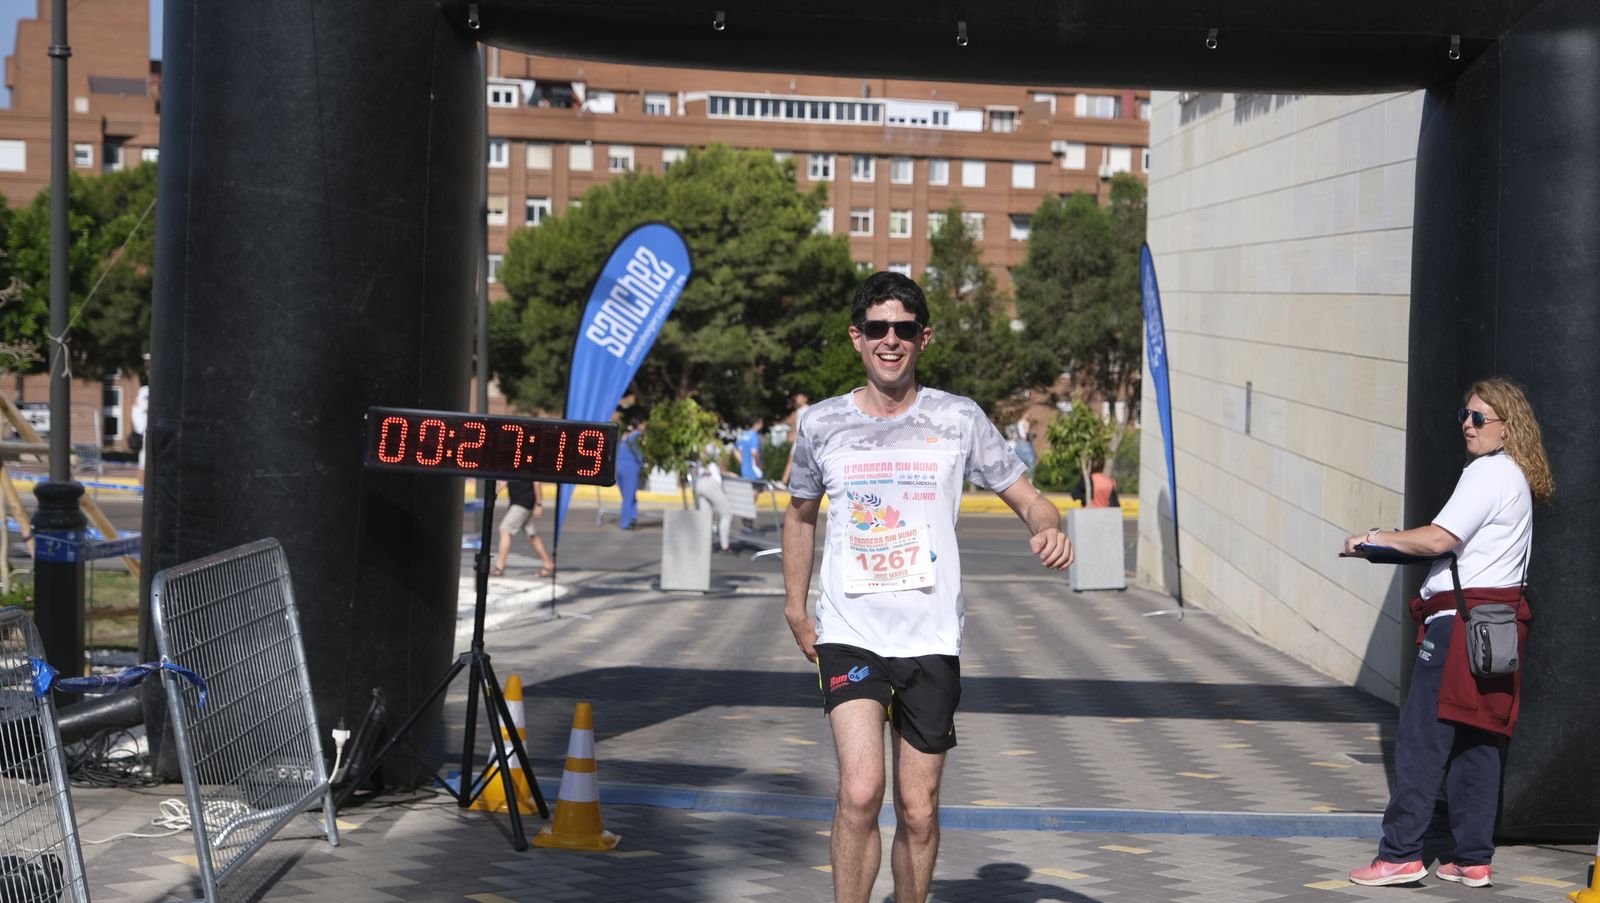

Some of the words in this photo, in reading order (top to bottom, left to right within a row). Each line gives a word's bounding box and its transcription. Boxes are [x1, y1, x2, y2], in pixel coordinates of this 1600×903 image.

[852, 462, 893, 474] CARRERA
[895, 461, 911, 472] SIN
[913, 462, 938, 472] HUMO
[903, 491, 909, 501] 4
[912, 492, 936, 501] JUNIO
[856, 545, 920, 572] 1267
